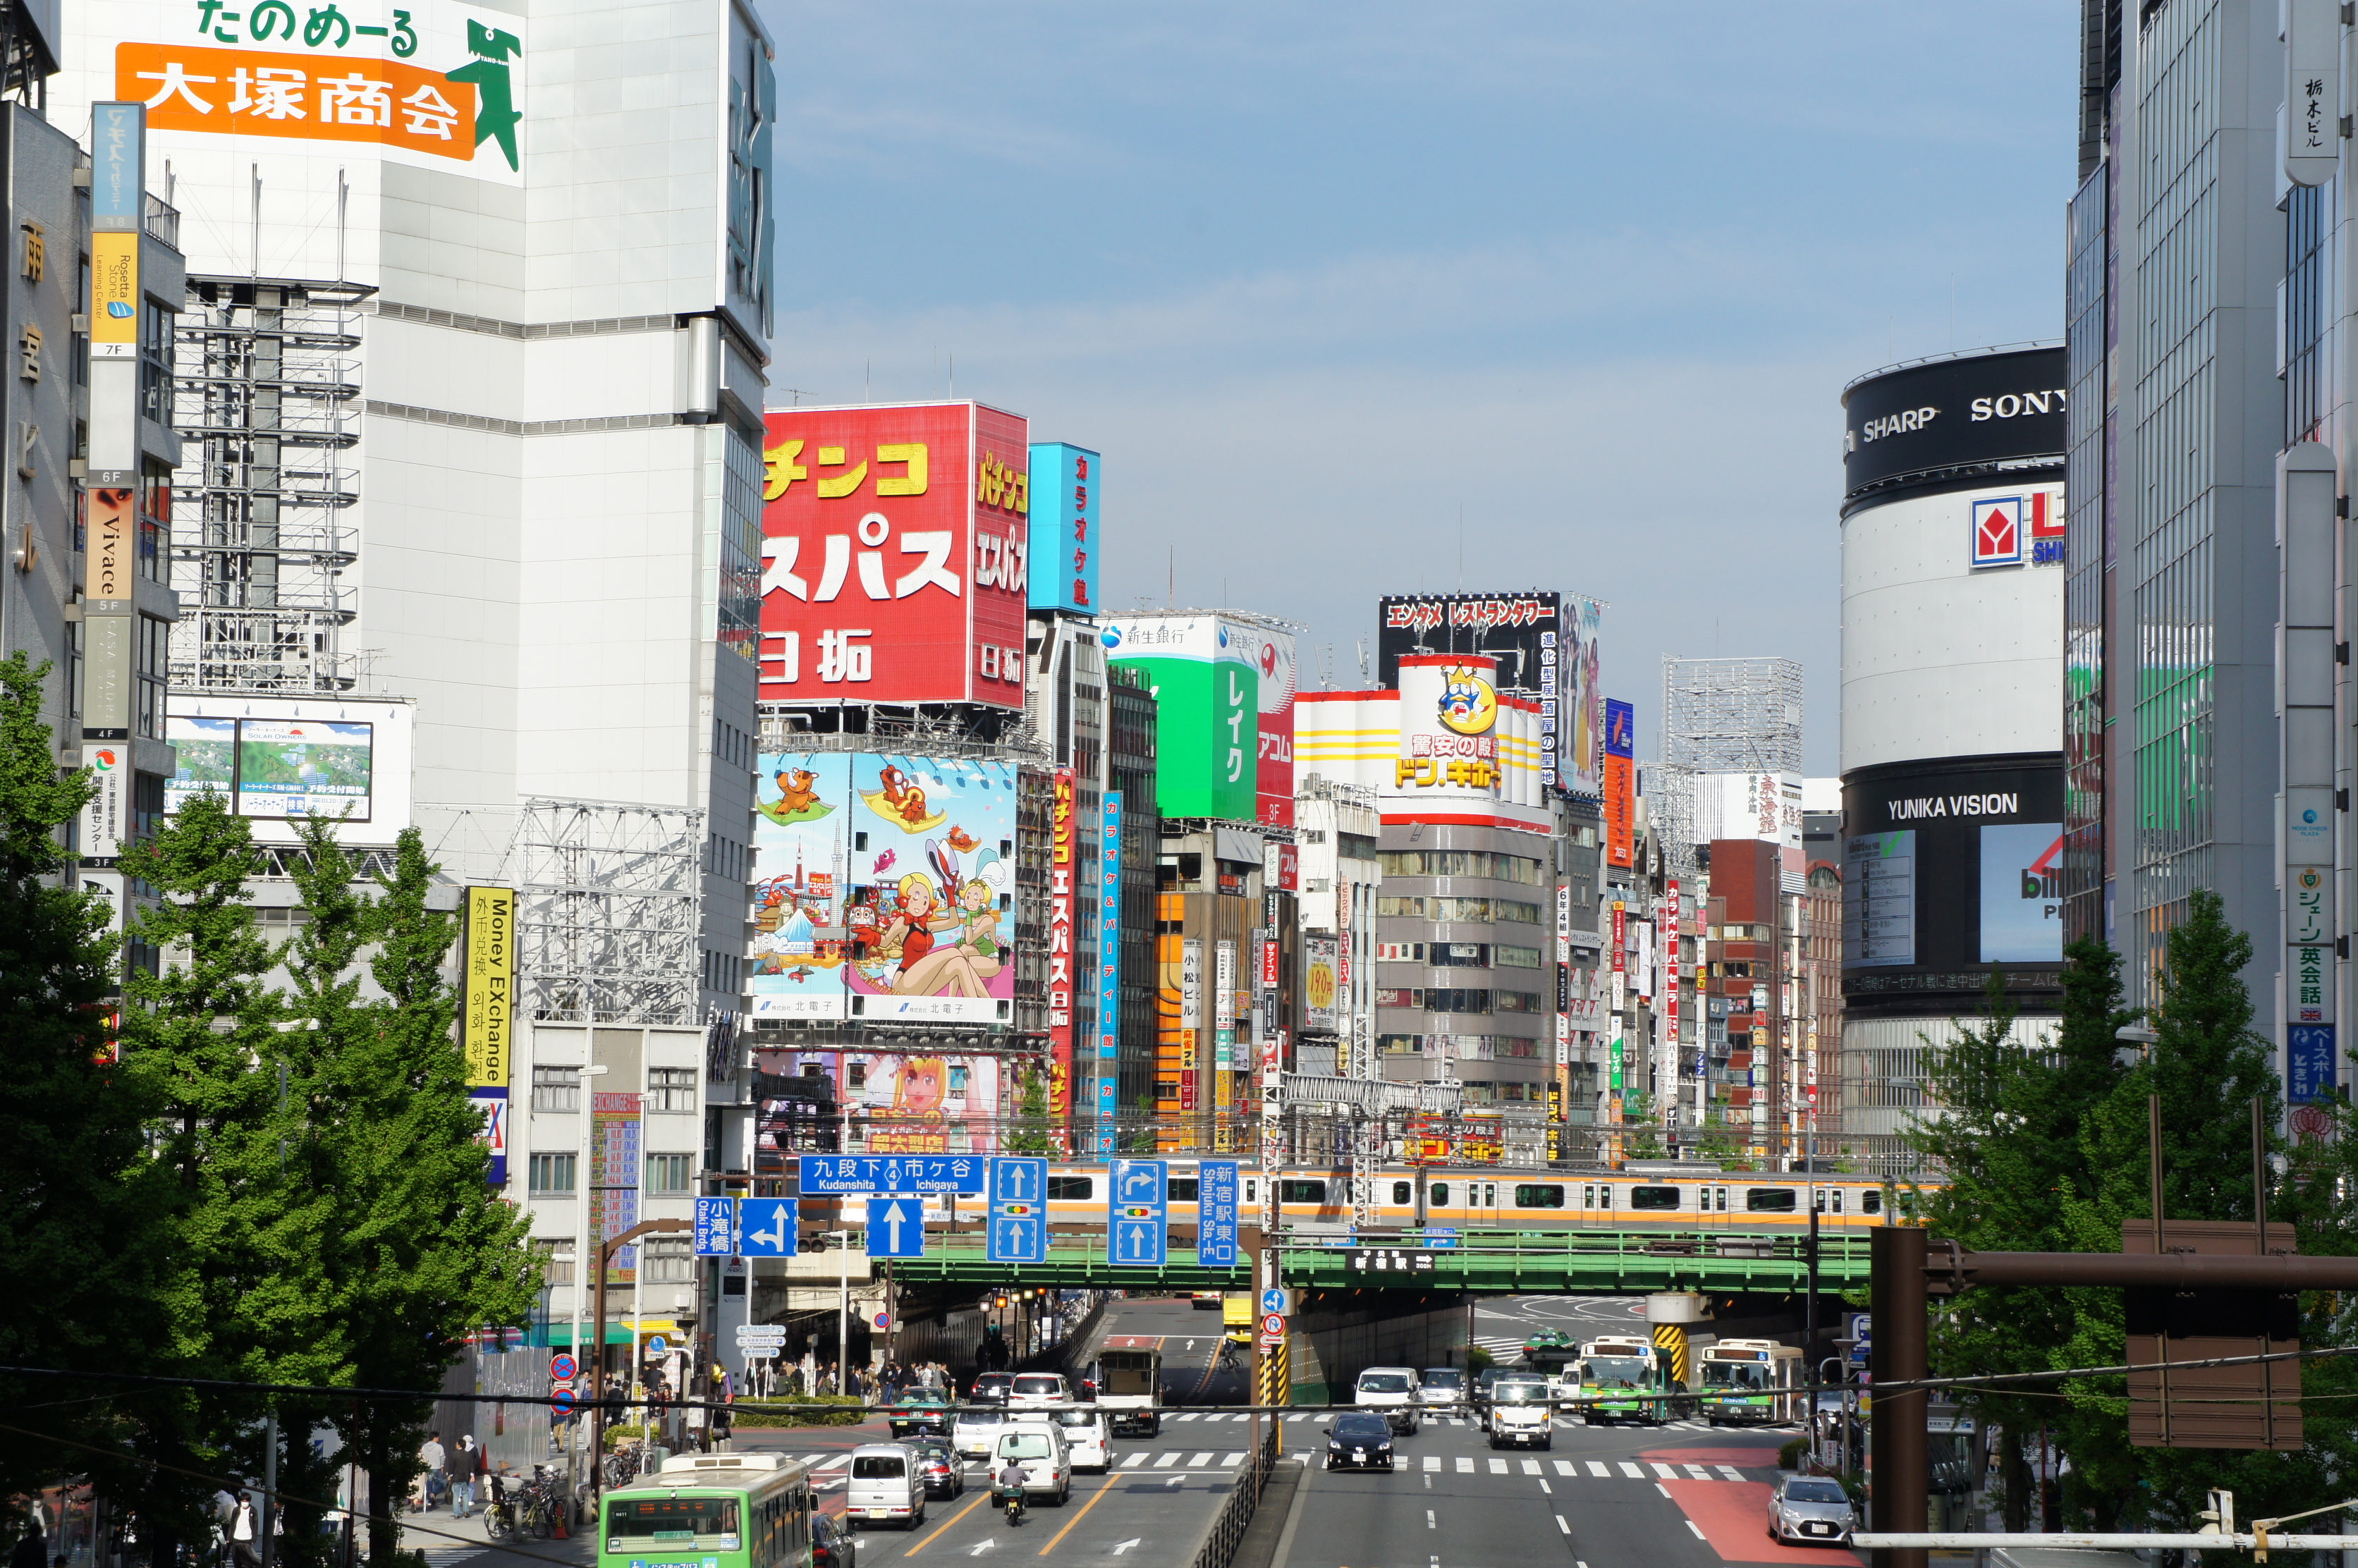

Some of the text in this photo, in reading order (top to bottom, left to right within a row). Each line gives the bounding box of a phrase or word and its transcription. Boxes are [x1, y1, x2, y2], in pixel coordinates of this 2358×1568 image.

[197, 0, 417, 58] たのめーる
[481, 56, 508, 66] TANO-kun
[135, 62, 459, 140] 大塚商会
[2305, 78, 2323, 147] 栃木ビル
[96, 255, 104, 319] Learning Center
[109, 264, 118, 298] Stone
[120, 255, 129, 298] Rosetta
[106, 345, 122, 355] 7F
[1864, 407, 1935, 443] SHARP
[102, 472, 121, 482] 6F
[977, 450, 1027, 513] パチンコ
[1073, 455, 1089, 607] カラオケ館
[102, 515, 120, 595] Vivace
[977, 523, 1027, 593] エスパス
[99, 601, 118, 610] 5F
[1387, 603, 1443, 628] エンタメ
[1448, 599, 1555, 628] レストランタワー
[1127, 630, 1184, 644] 新生銀行
[1229, 634, 1254, 652] 新生銀行
[981, 642, 1021, 683] 日拓
[1541, 631, 1556, 785] 進化型居酒屋の聖地
[1227, 670, 1243, 783] レイク
[1258, 731, 1291, 763] アコム
[1412, 734, 1499, 759] 驚安の殿堂
[287, 798, 305, 811] 検索
[308, 785, 366, 795] 予約受付開始
[1758, 774, 1778, 833] 東海苑
[1888, 794, 2017, 821] YUNIKA VISION
[1054, 781, 1071, 864] パチンコ
[1269, 804, 1279, 820] 3F
[492, 899, 507, 968] Money
[1051, 871, 1069, 984] エスパス
[1668, 888, 1678, 1003] カラオケ パセラ
[1183, 955, 1195, 1016] 小松ビル
[1310, 969, 1332, 996] 190円
[471, 991, 487, 1033] 외화
[795, 1000, 832, 1012] 北電子
[930, 1003, 964, 1015] 北電子
[1051, 991, 1068, 1027] 日拓
[2295, 1054, 2307, 1095] ときわ
[594, 1094, 627, 1112] EXCHANGE
[872, 1135, 944, 1153] 超大型店
[814, 1159, 881, 1177] 九段下
[889, 1170, 896, 1179] 4
[819, 1180, 958, 1192] Kudanshita Ichigaya
[1202, 1169, 1215, 1215] Shinjuku
[697, 1201, 709, 1252] Otaki Brdg.
[710, 1201, 730, 1252] 小滝橋
[1216, 1166, 1233, 1260] 新宿駅東口
[623, 1270, 635, 1281] HERE
[1355, 1257, 1407, 1269] 新宿駅
